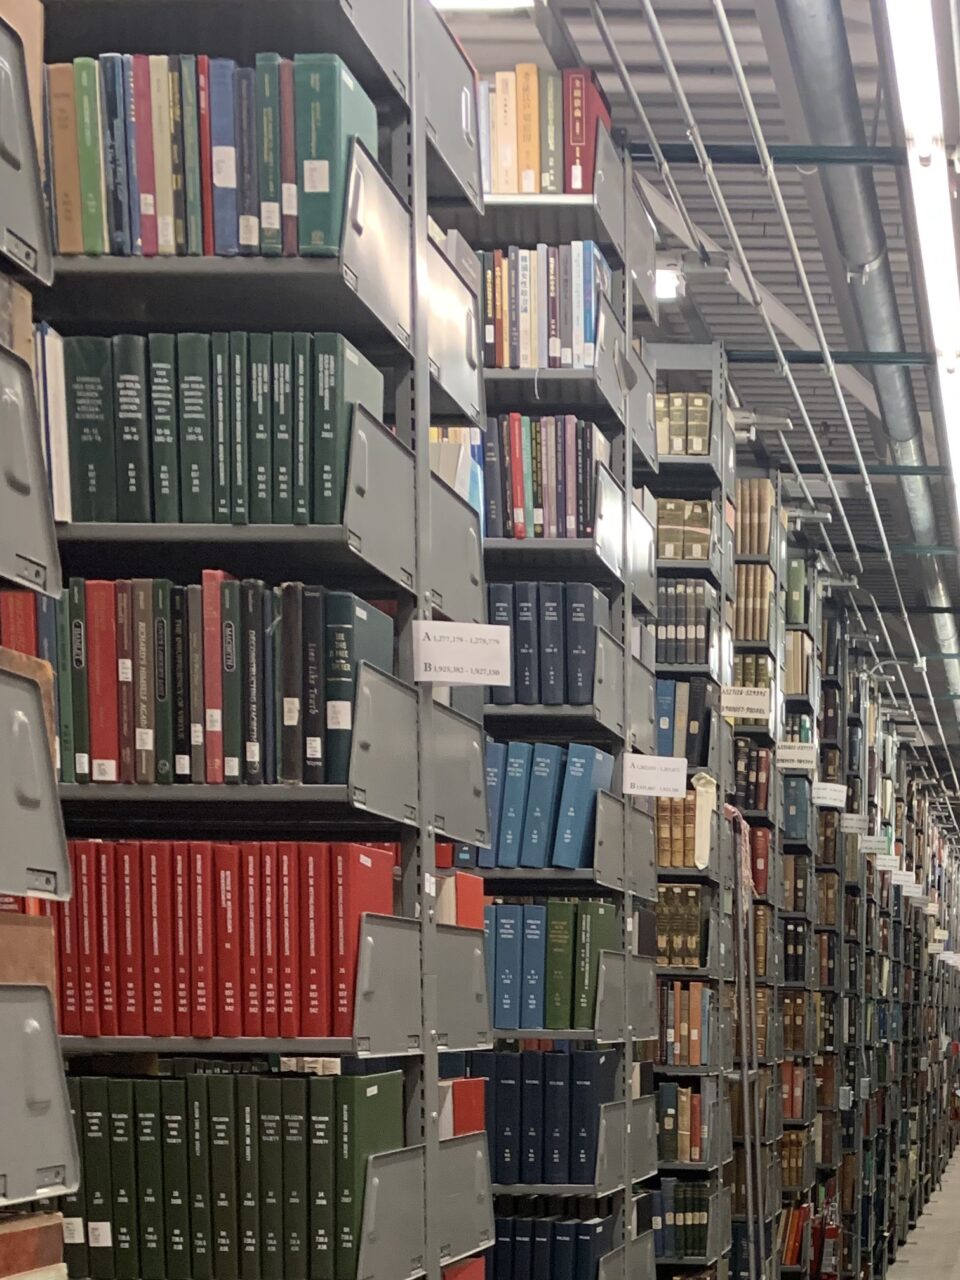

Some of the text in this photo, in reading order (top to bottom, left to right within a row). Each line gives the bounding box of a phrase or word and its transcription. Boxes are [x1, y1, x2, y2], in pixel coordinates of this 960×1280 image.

[423, 632, 431, 642] A
[226, 627, 234, 665] MACBETH
[424, 662, 432, 672] B
